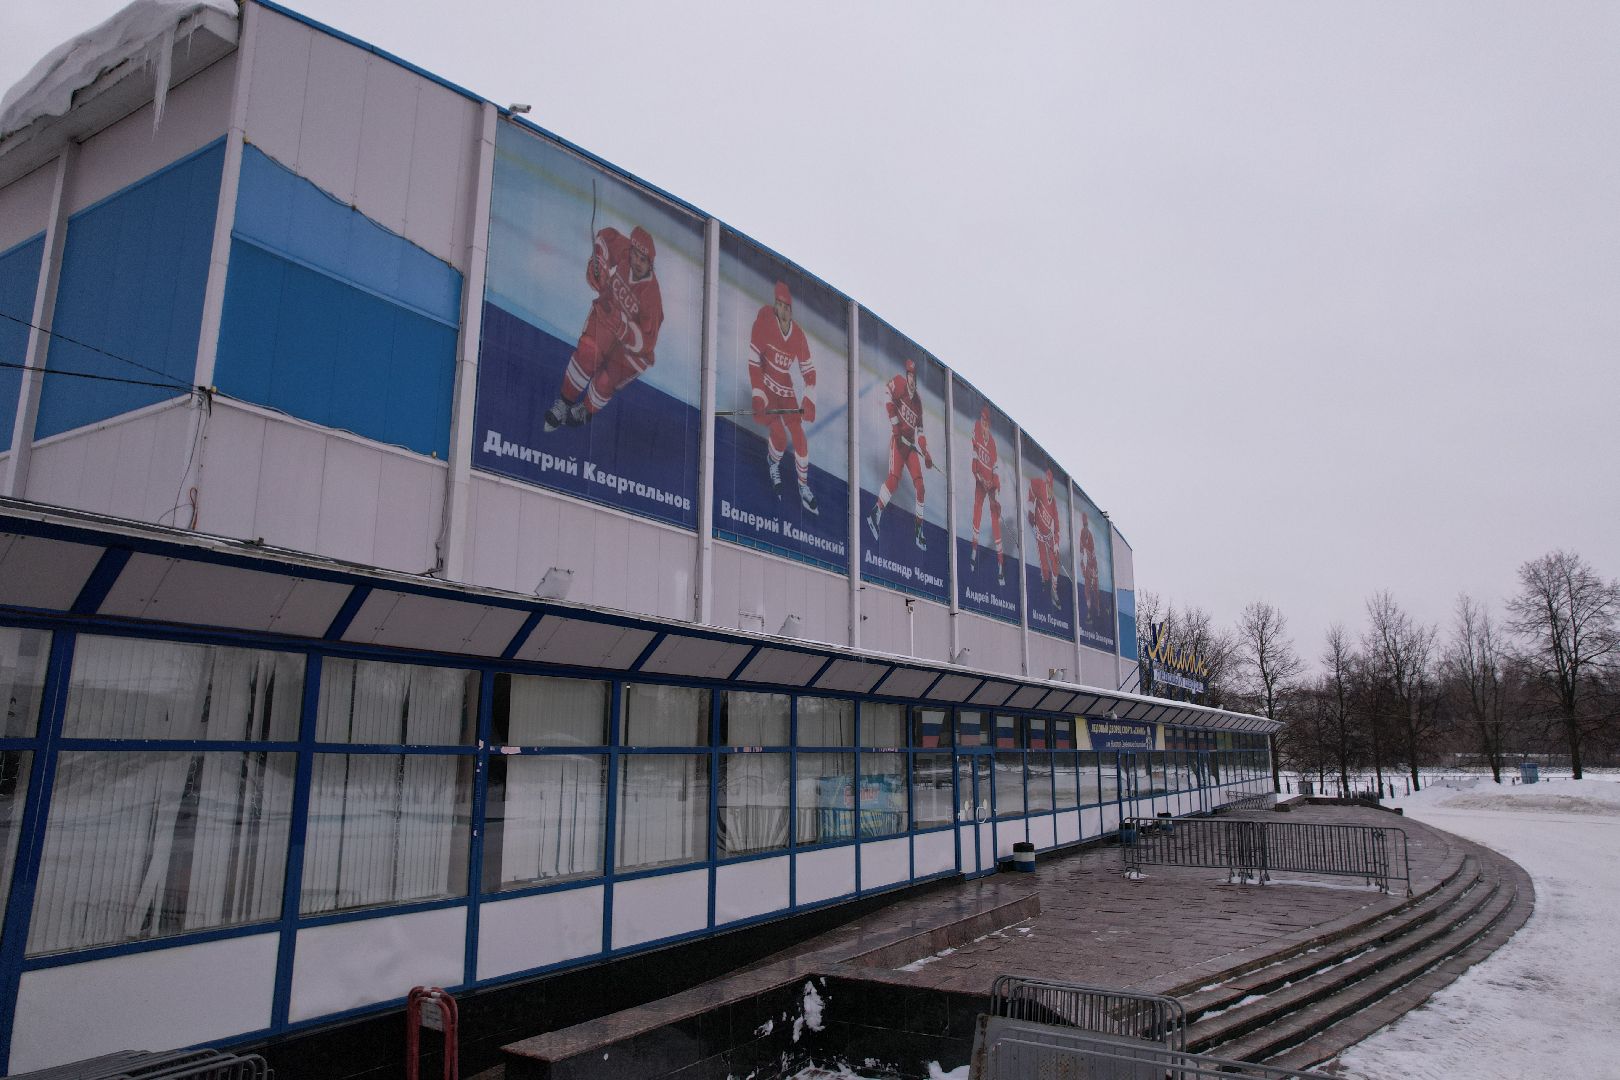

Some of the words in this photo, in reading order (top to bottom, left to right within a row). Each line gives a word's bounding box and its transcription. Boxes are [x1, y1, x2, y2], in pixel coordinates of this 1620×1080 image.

[612, 277, 640, 315] СССР
[774, 352, 793, 369] СССР
[483, 429, 578, 477] Дмитрий
[583, 460, 691, 511] Квартальнов
[721, 499, 780, 533] Валерий
[783, 520, 845, 556] Каменский
[864, 549, 913, 579] Александр
[914, 566, 944, 588] Черных
[965, 586, 990, 604] Андрей
